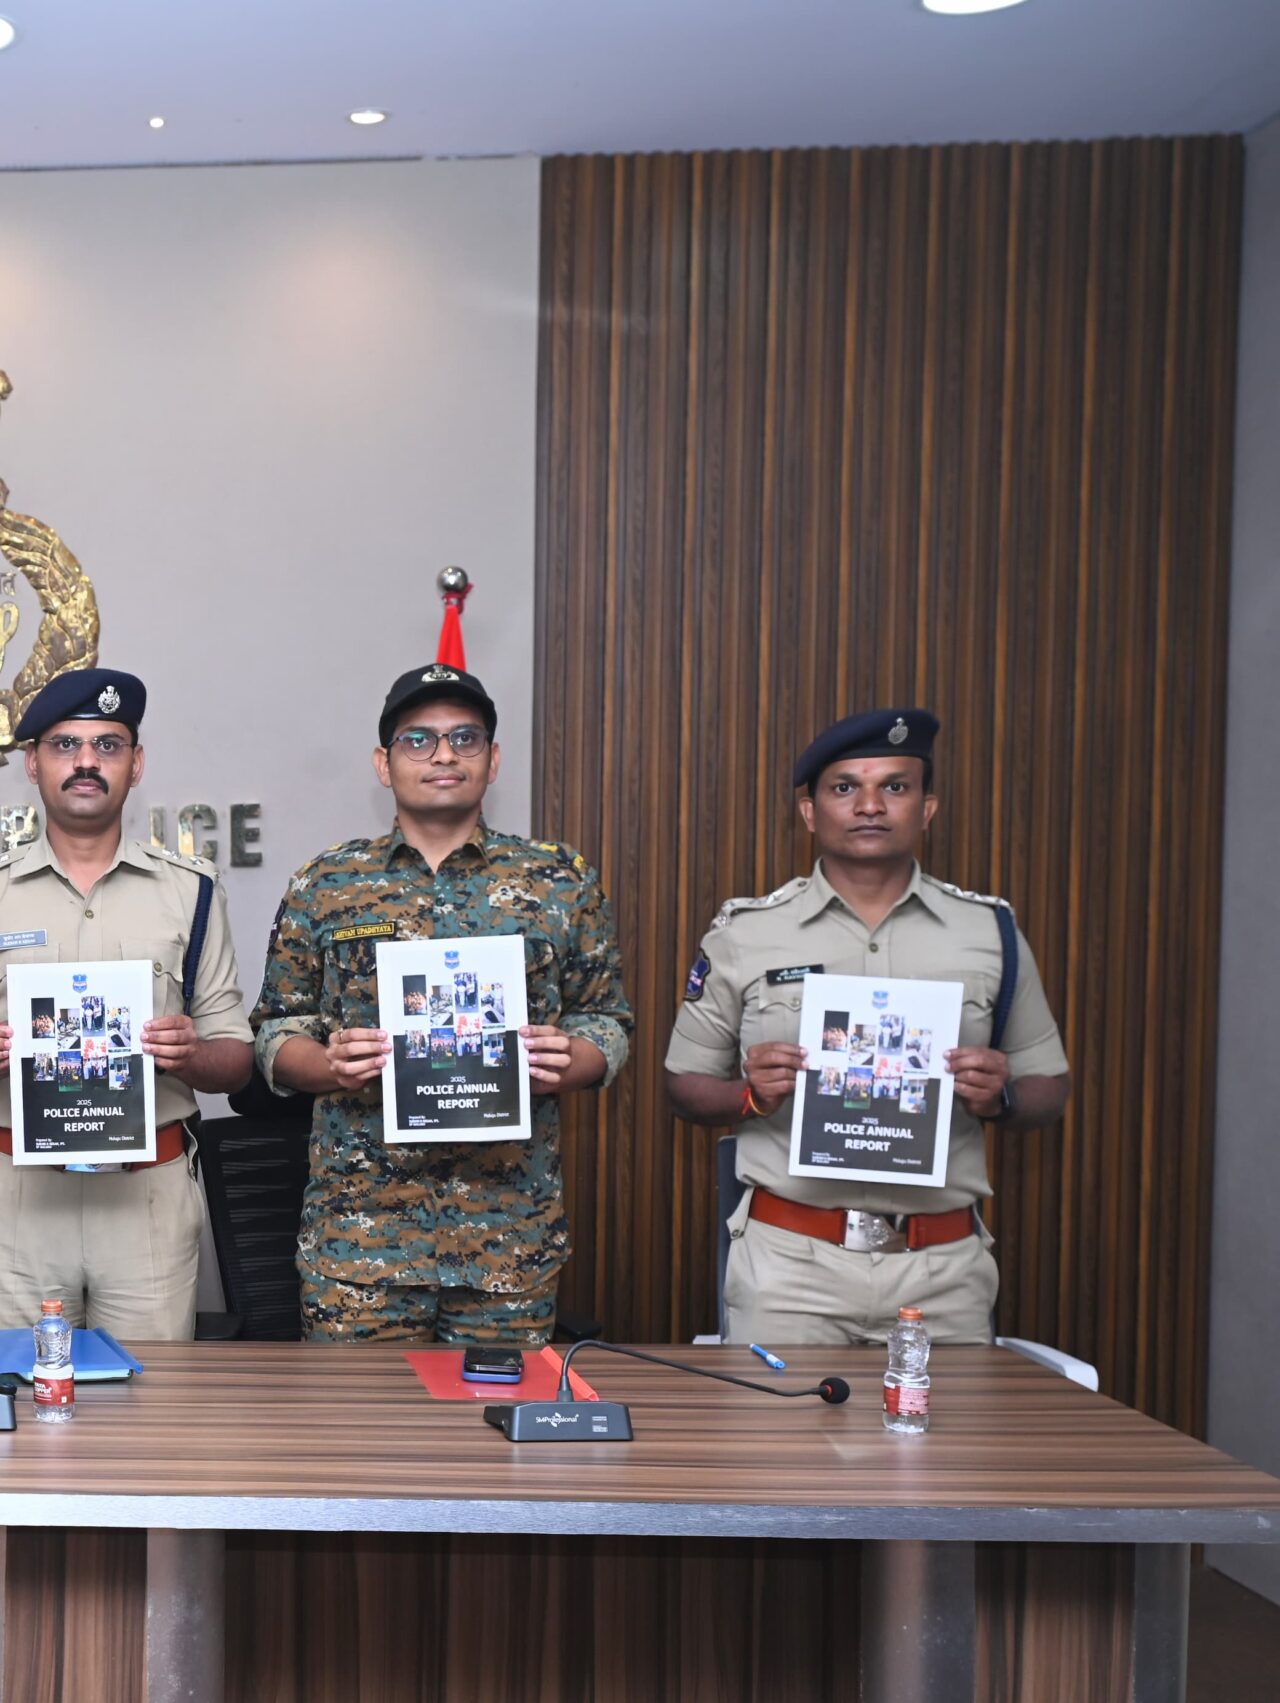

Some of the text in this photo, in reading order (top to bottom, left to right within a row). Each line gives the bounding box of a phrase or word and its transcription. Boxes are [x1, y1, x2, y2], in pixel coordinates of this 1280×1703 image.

[1, 803, 262, 867] PICE
[416, 1083, 500, 1095] POLICE ANNUAL
[76, 1099, 92, 1107] 2025
[438, 1098, 480, 1109] REPORT
[43, 1106, 125, 1118] POLICE ANNUAL
[64, 1121, 105, 1132] REPORT
[824, 1122, 914, 1139] POLICE ANNUAL
[845, 1138, 891, 1152] REPORT
